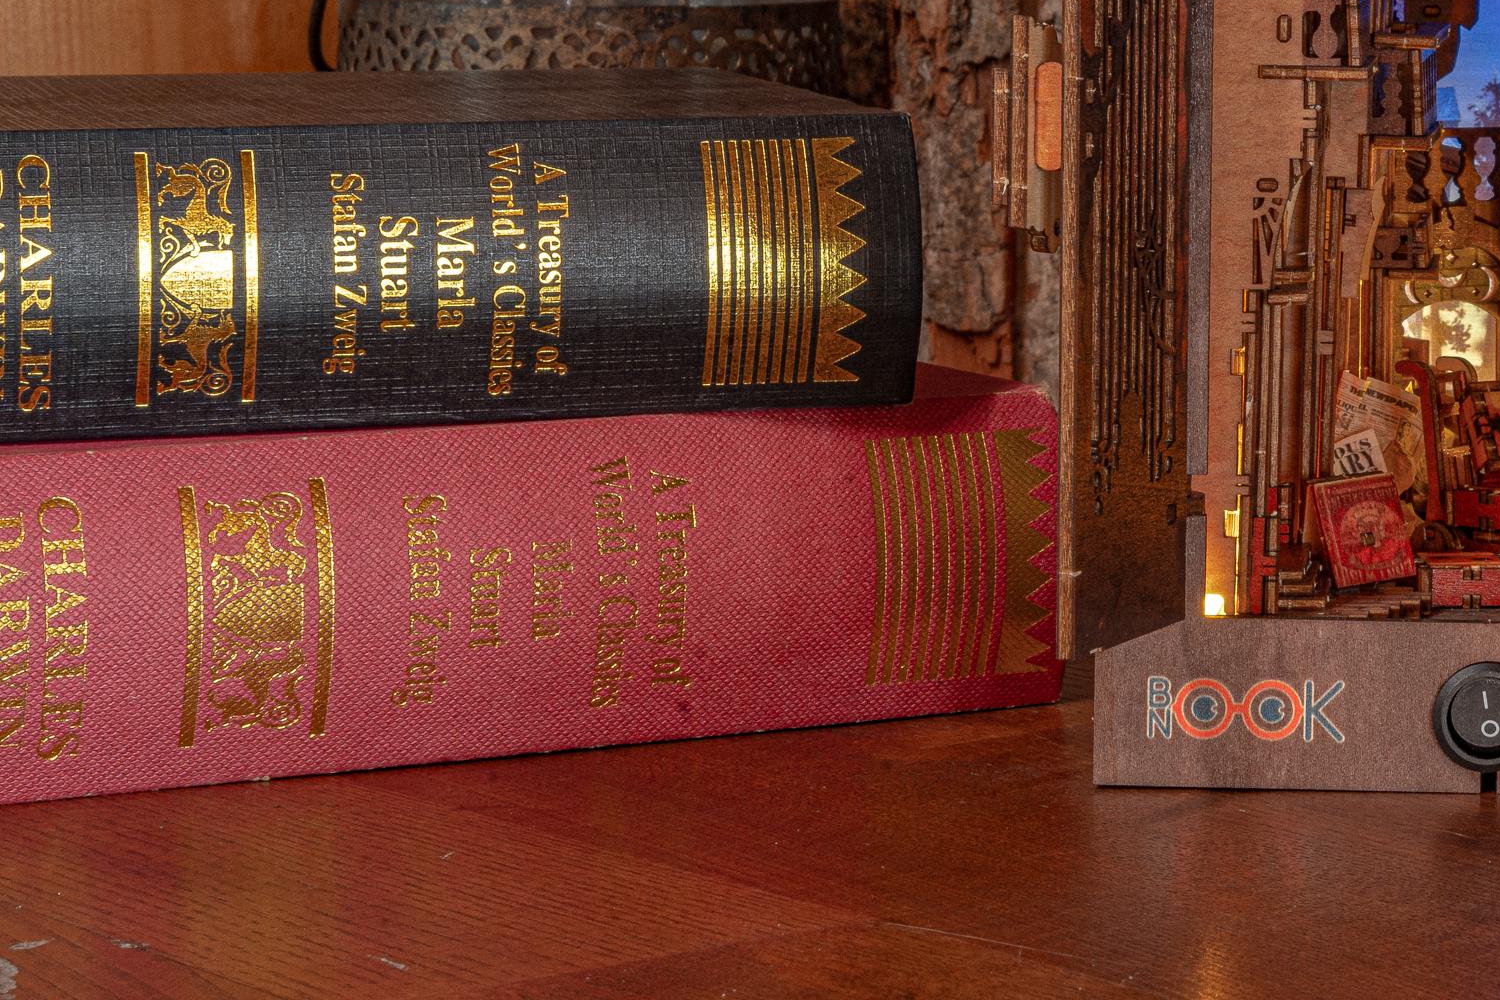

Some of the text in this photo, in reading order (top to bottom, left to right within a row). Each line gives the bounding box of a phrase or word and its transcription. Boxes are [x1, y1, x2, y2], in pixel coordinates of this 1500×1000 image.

[17, 154, 53, 412] CHARLES
[322, 173, 368, 375] Stafan Zweig
[379, 215, 420, 333] Stuart
[436, 216, 476, 330] Marla
[529, 161, 570, 376] A Treasury of
[38, 496, 88, 761] CHARLES
[390, 494, 452, 708] Stafan Zweig
[469, 547, 513, 648] Stuart
[644, 469, 697, 689] A Treasury of
